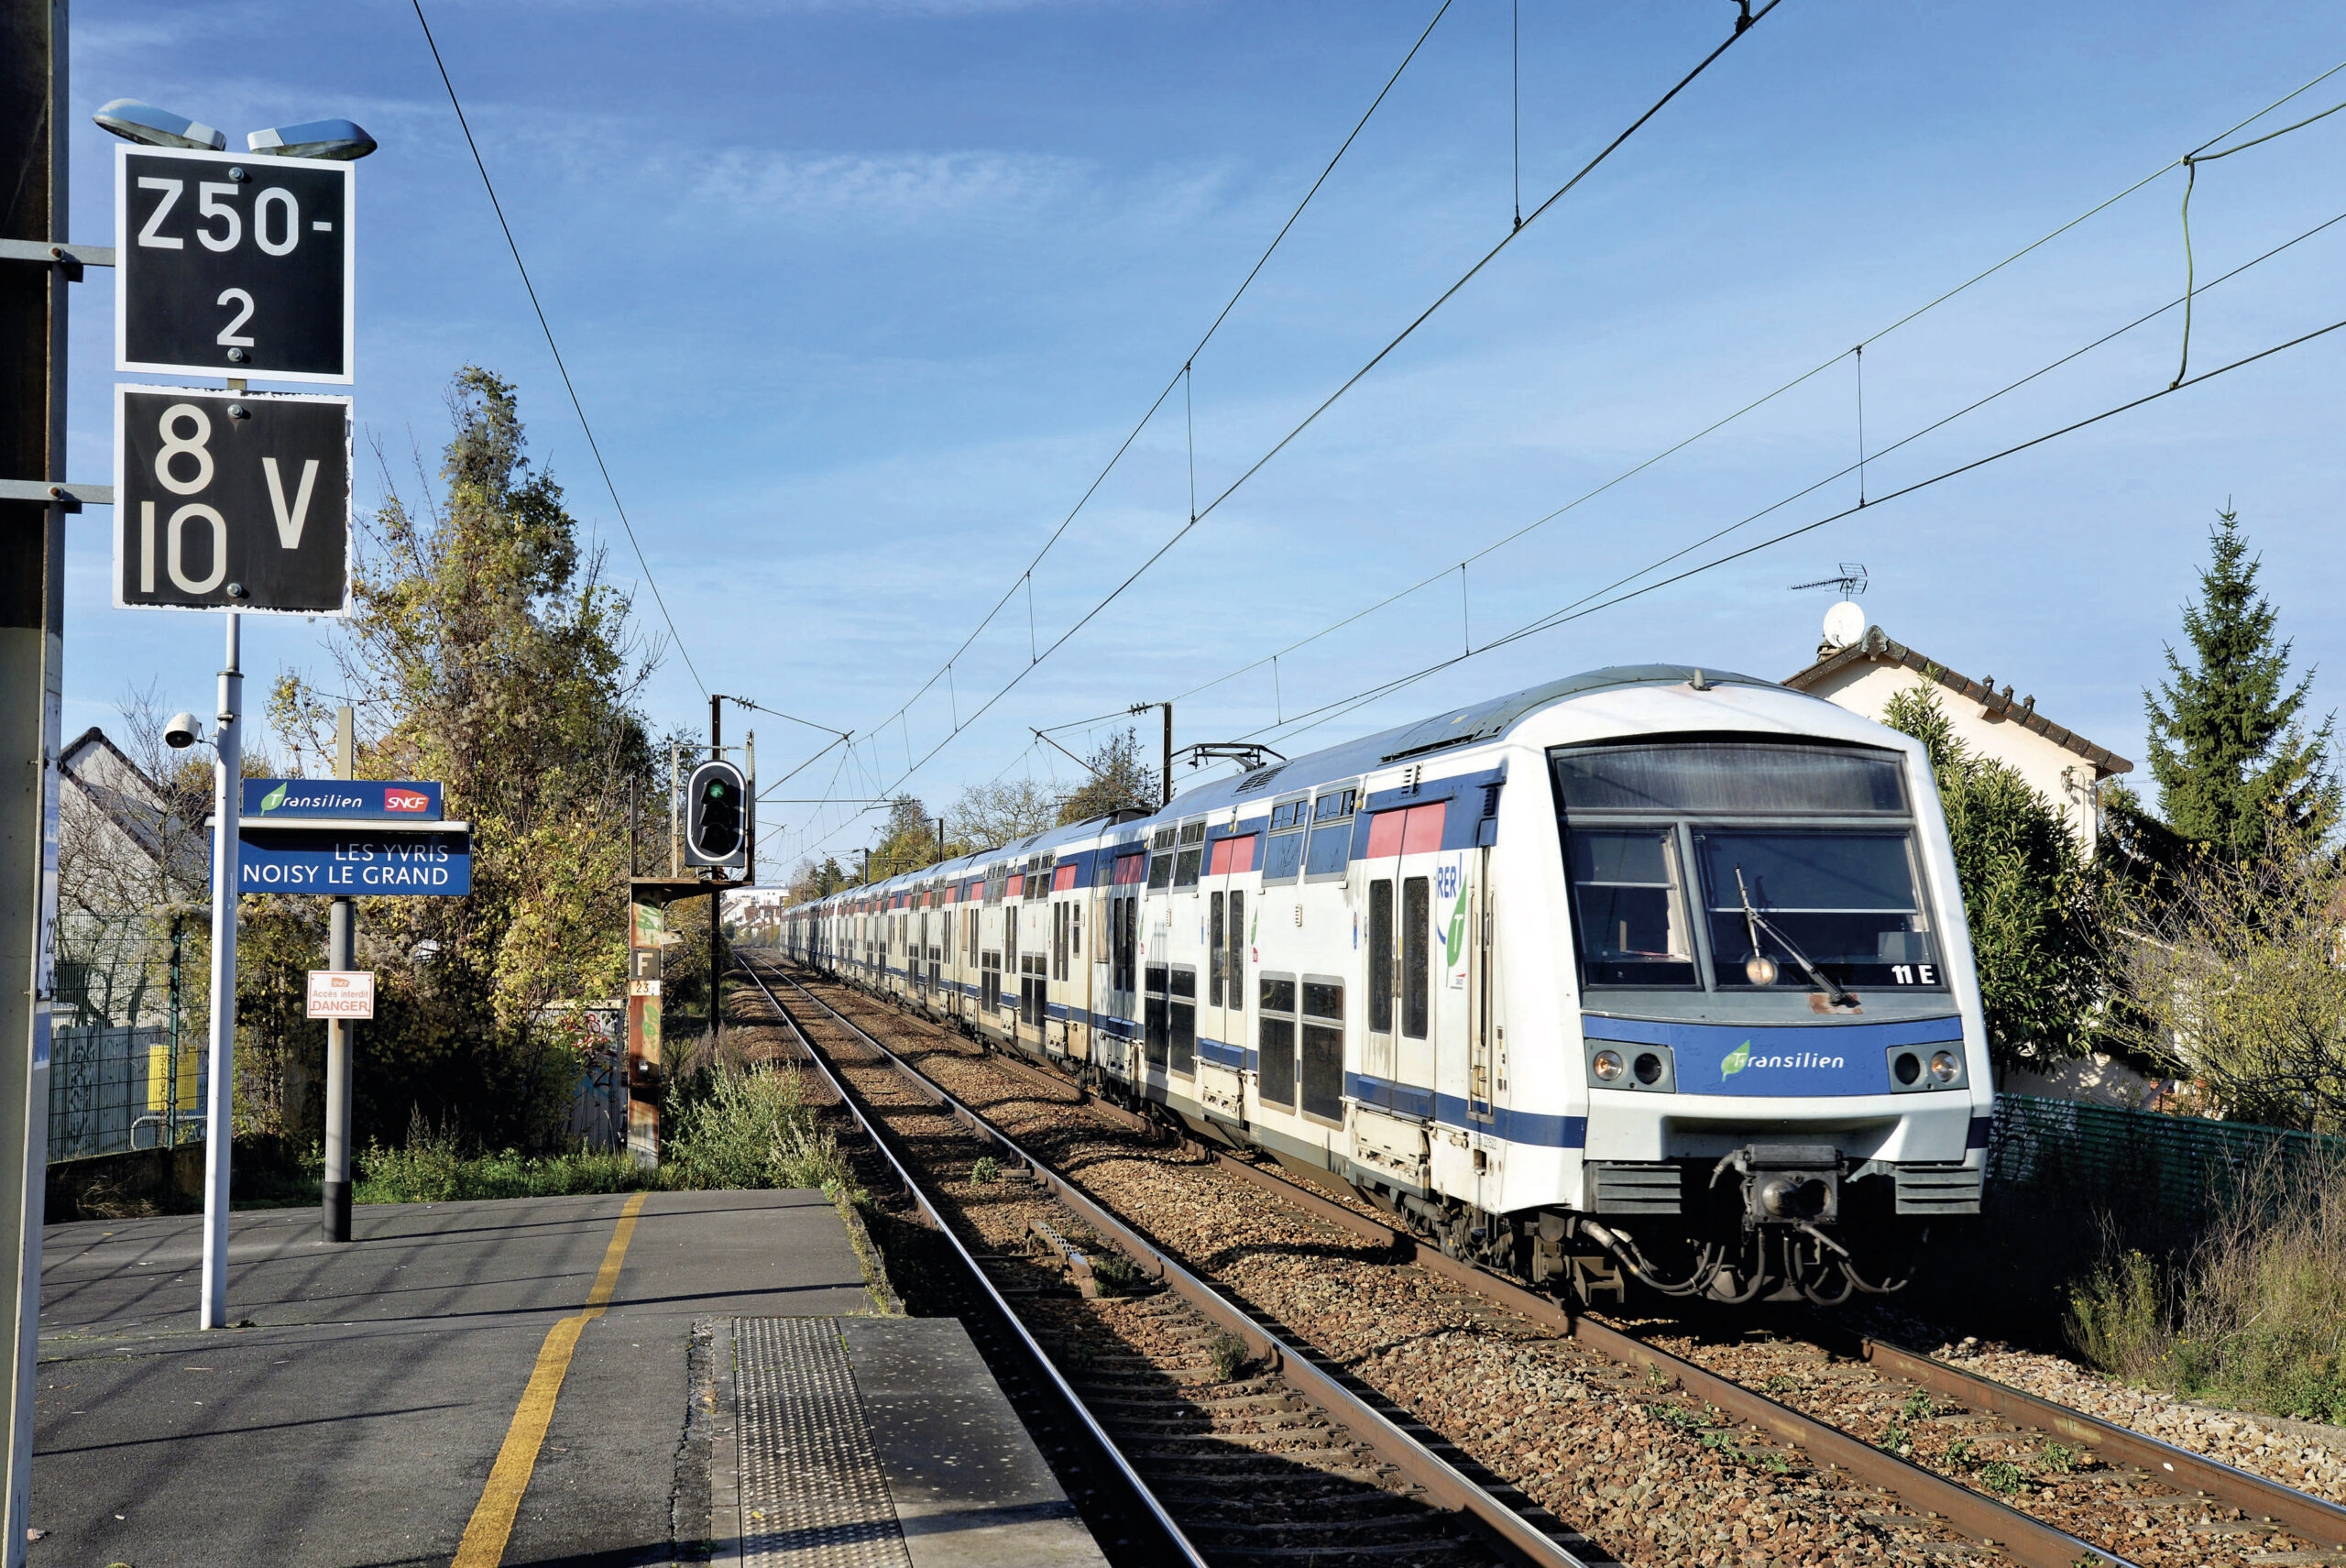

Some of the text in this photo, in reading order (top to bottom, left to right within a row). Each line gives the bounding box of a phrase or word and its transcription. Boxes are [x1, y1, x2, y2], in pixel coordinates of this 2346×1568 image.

[137, 177, 333, 256] Z50-
[216, 288, 255, 347] 2
[155, 403, 214, 495] 8
[262, 457, 319, 549] V
[141, 501, 226, 594] 10
[269, 794, 363, 808] Transilien
[387, 797, 427, 808] SNCF
[335, 843, 448, 862] LES YVRIS
[243, 865, 448, 885] NOISY LE GRAND
[1437, 866, 1457, 898] RER
[637, 953, 653, 976] F
[1891, 965, 1935, 983] 11 E
[340, 990, 368, 998] interdit
[312, 1001, 367, 1012] DANGER
[1734, 1052, 1845, 1069] Transilien
